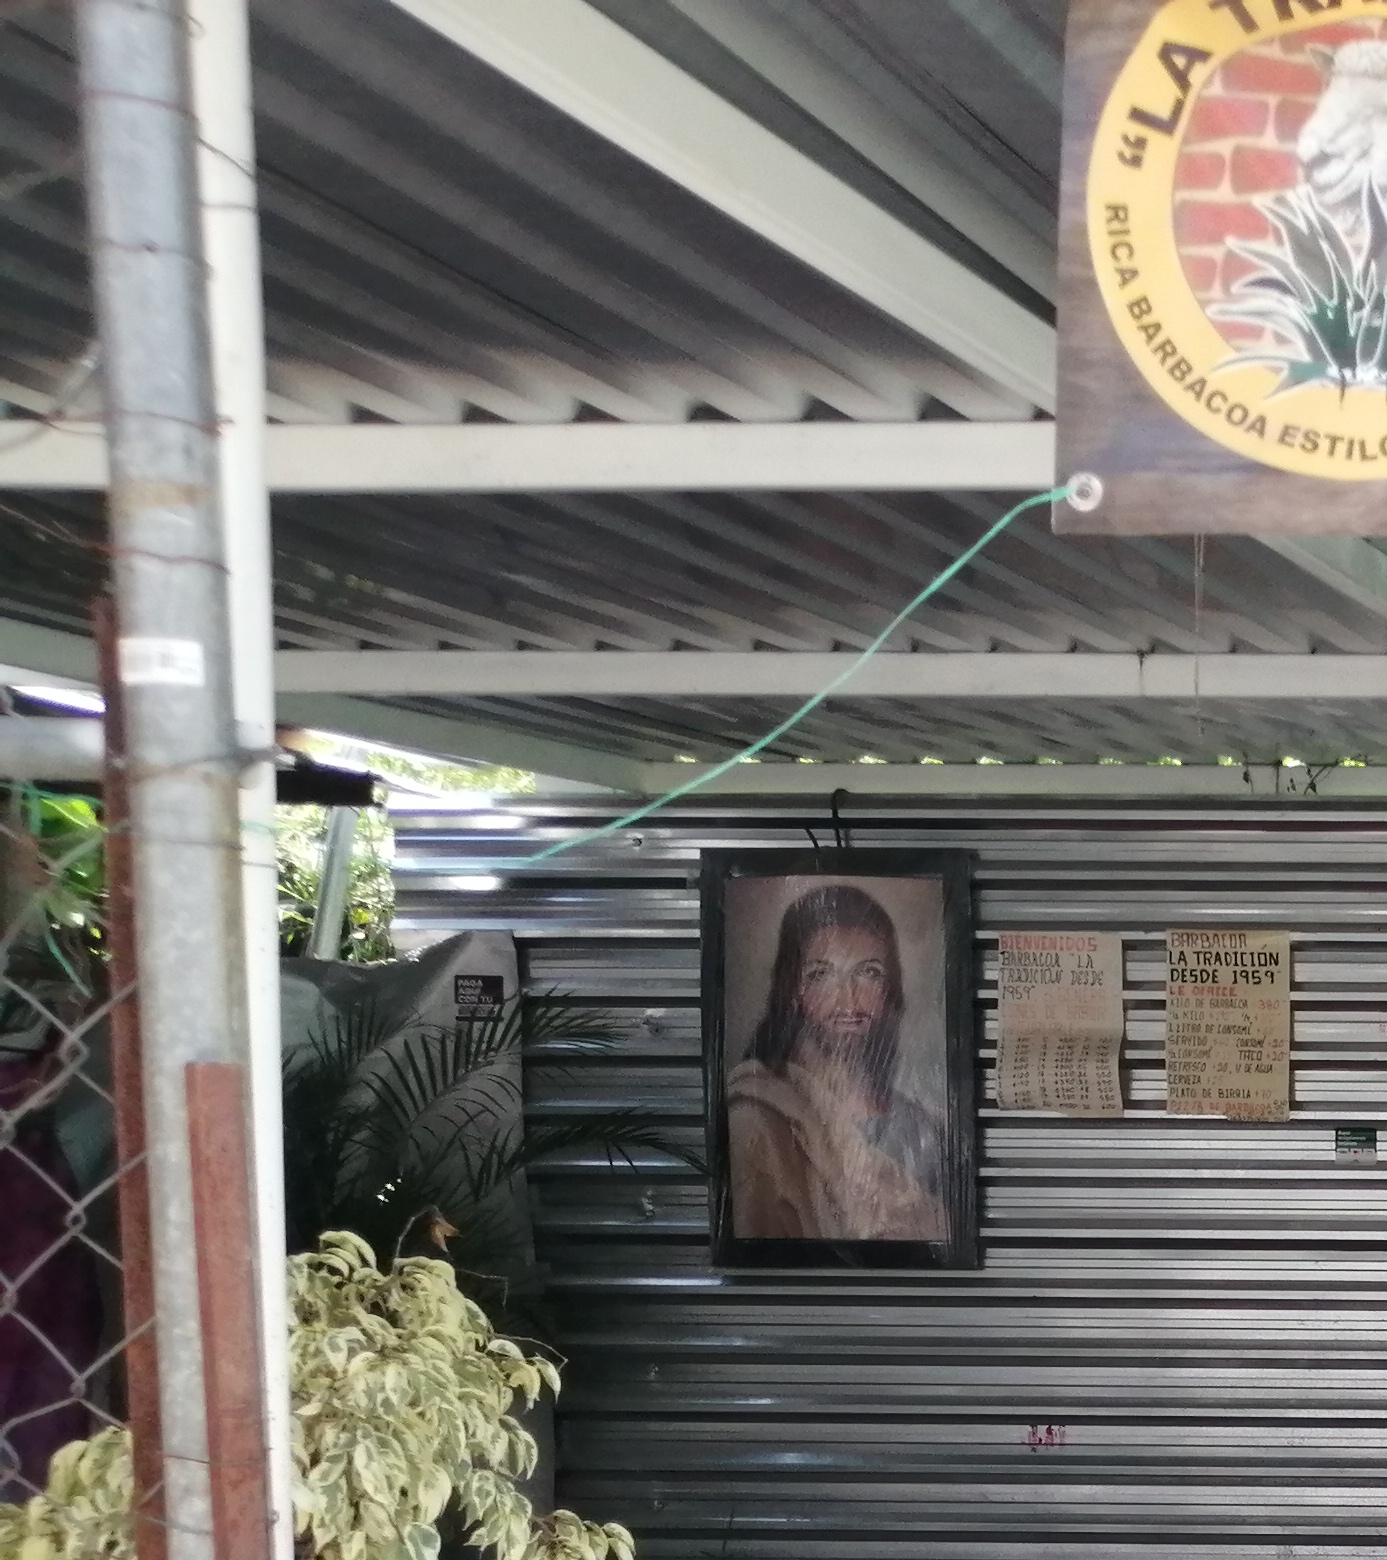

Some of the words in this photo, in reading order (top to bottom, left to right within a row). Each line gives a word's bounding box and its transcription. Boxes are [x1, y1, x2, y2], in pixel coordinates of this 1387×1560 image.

[1105, 203, 1140, 289] RICA
[1127, 296, 1268, 440] BARBACOA
[1000, 936, 1098, 952] BIENVENIDOS
[1171, 932, 1248, 948] BARBACOA
[1169, 951, 1188, 966] LA
[1193, 944, 1279, 967] TRADICIÓN
[1170, 969, 1219, 984] DESDE
[1202, 1088, 1212, 1098] DE
